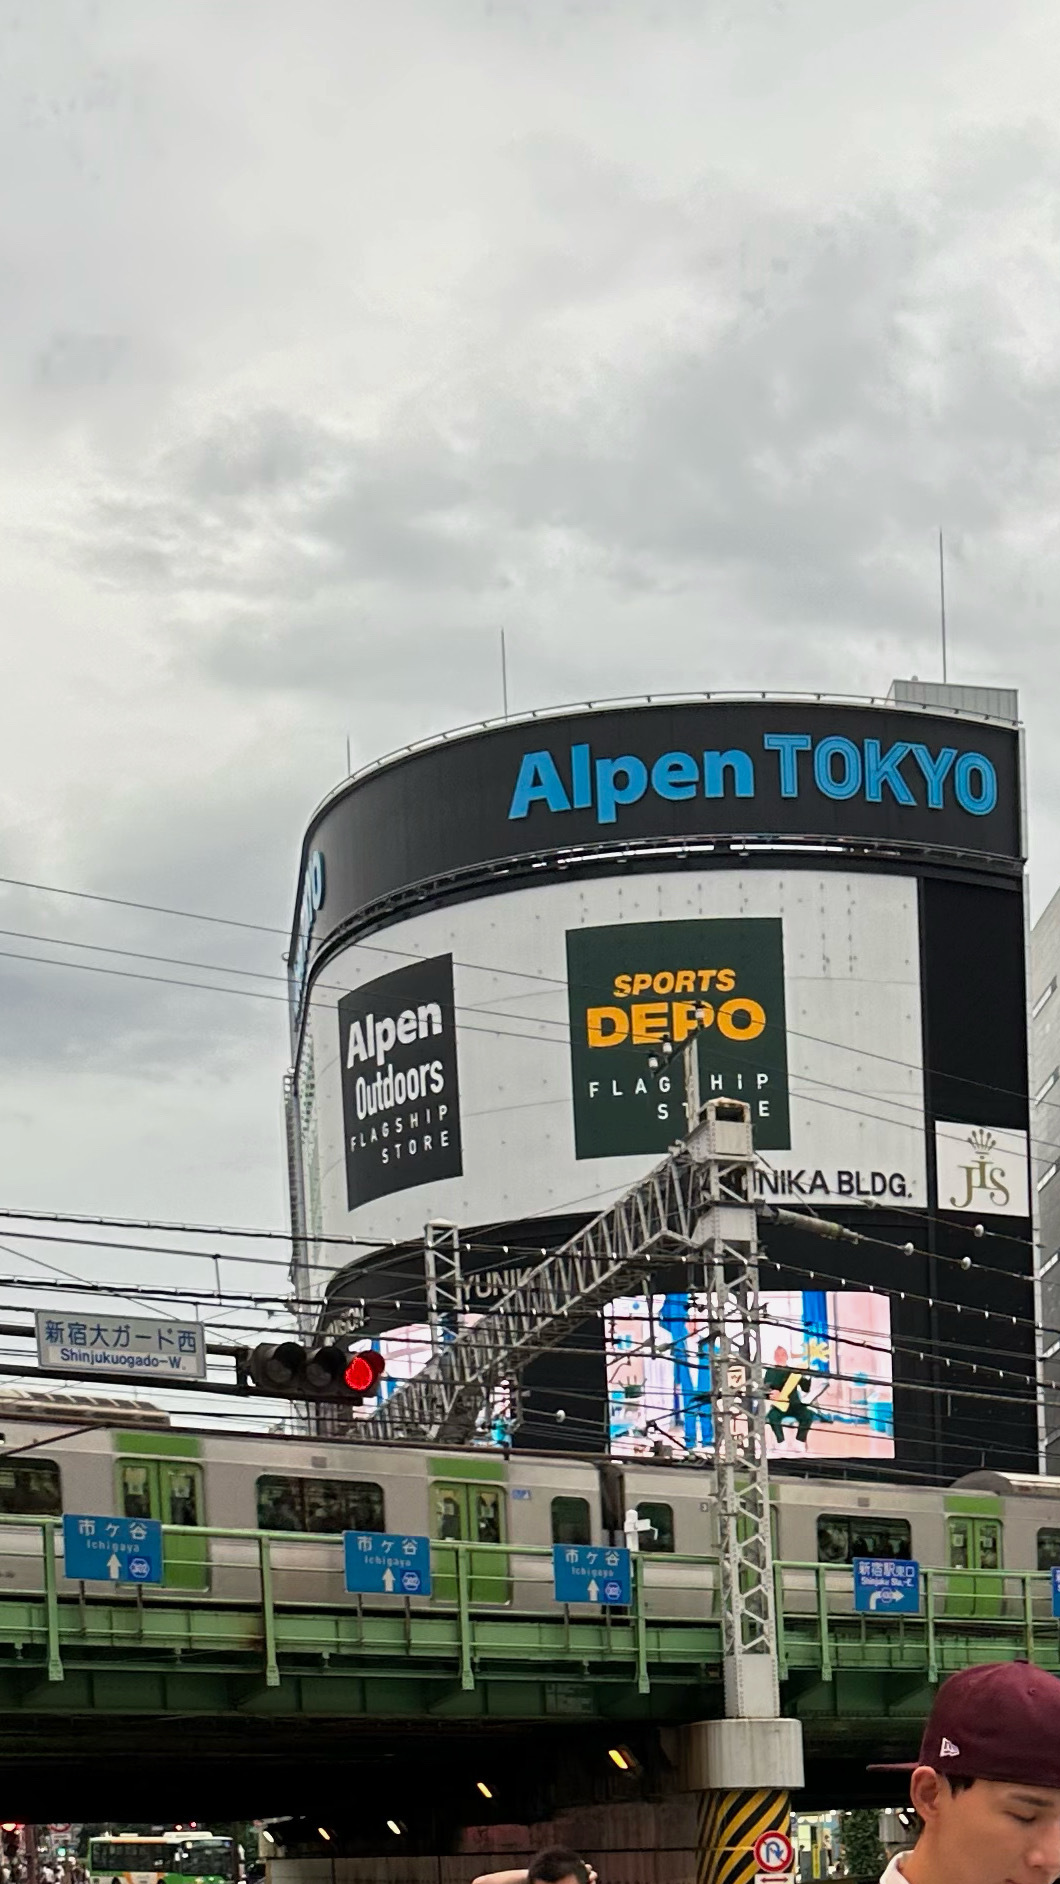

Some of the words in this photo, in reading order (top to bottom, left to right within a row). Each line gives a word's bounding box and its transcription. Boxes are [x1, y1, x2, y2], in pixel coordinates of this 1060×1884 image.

[508, 743, 755, 824] Alpen
[763, 733, 998, 816] TOKYO
[613, 968, 736, 997] SPORTS
[346, 1002, 443, 1069] Alpen
[586, 998, 766, 1048] DEPO
[355, 1060, 444, 1121] Outdoors
[589, 1073, 768, 1098] FLAGHIP
[350, 1104, 448, 1152] FLAGSHIP
[381, 1130, 450, 1164] STORE
[837, 1170, 913, 1199] BLDG.
[45, 1319, 197, 1354] 新宿大ガード西
[86, 1540, 140, 1553] Ichigaya
